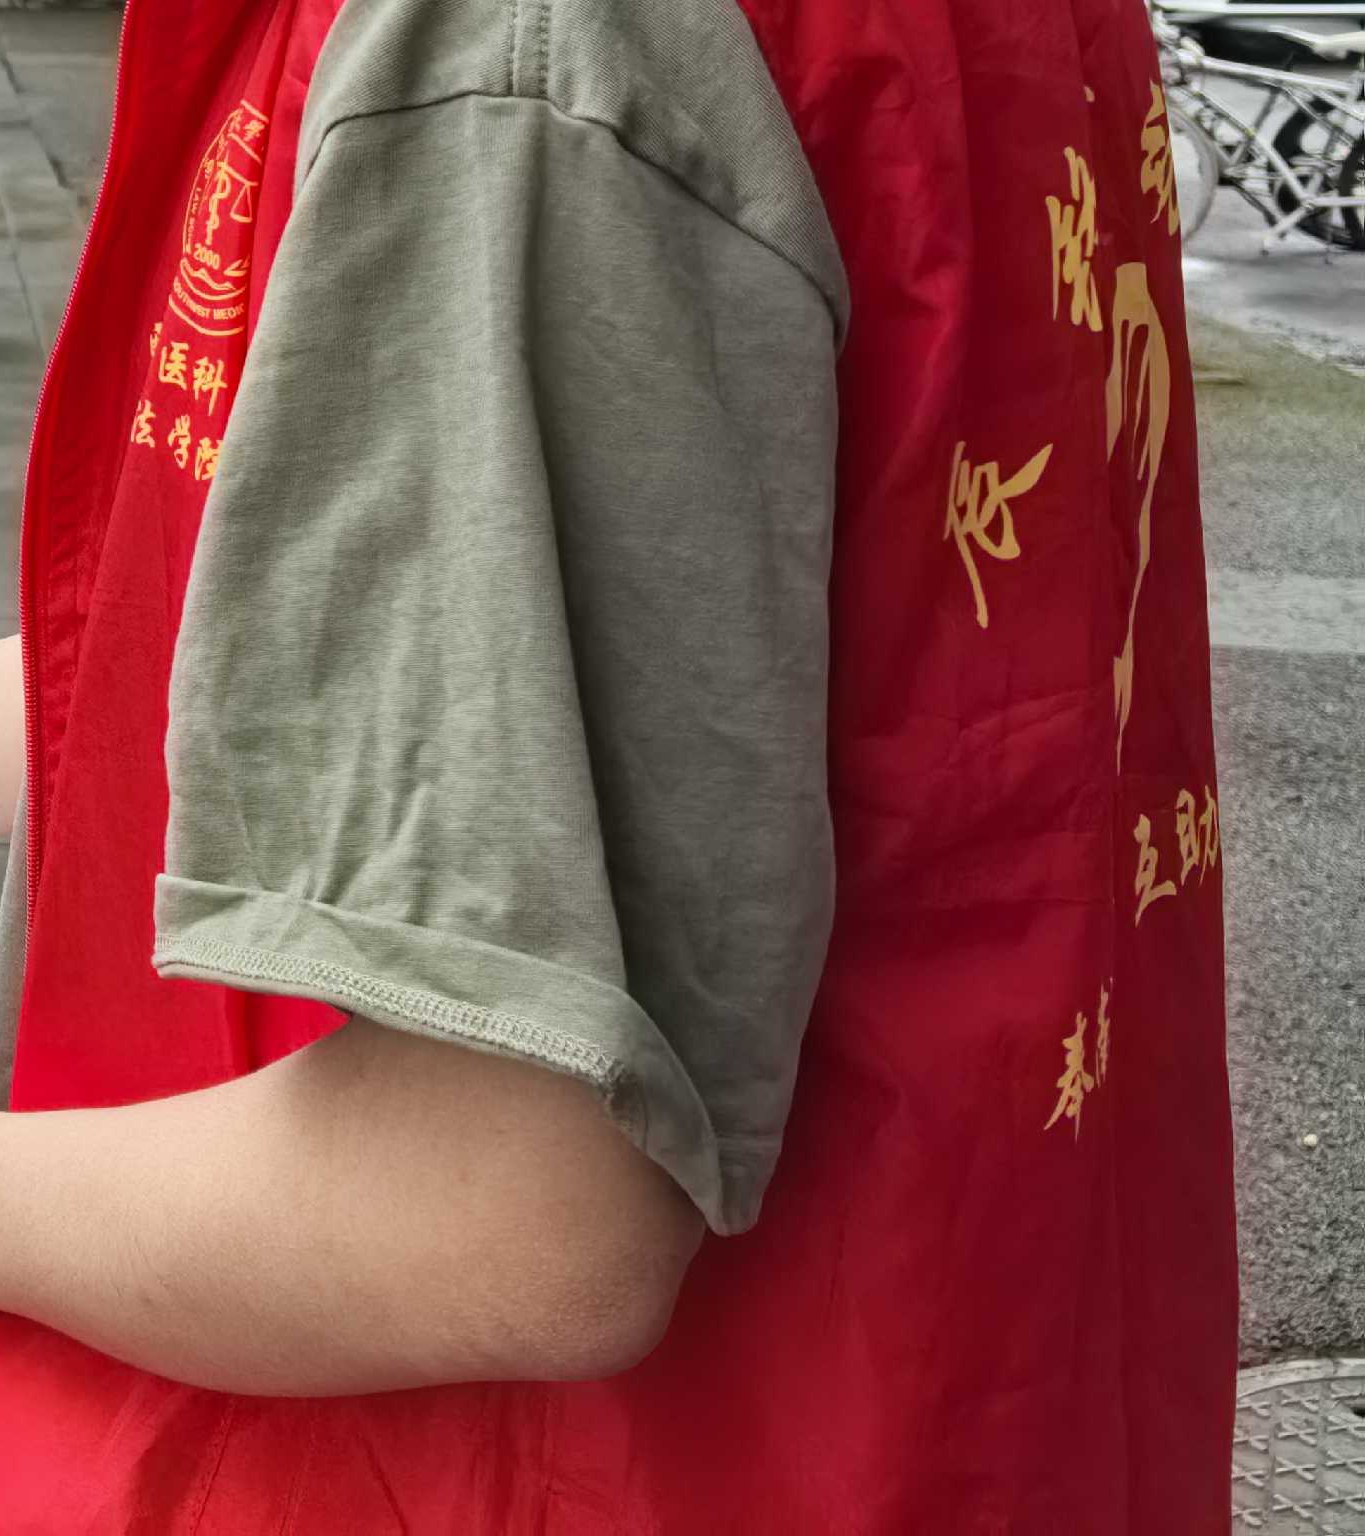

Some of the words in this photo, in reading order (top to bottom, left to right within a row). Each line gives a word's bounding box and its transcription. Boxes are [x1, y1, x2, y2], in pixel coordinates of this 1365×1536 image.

[193, 243, 221, 270] 2000
[131, 399, 223, 481] 法学院
[1133, 784, 1219, 928] 互助
